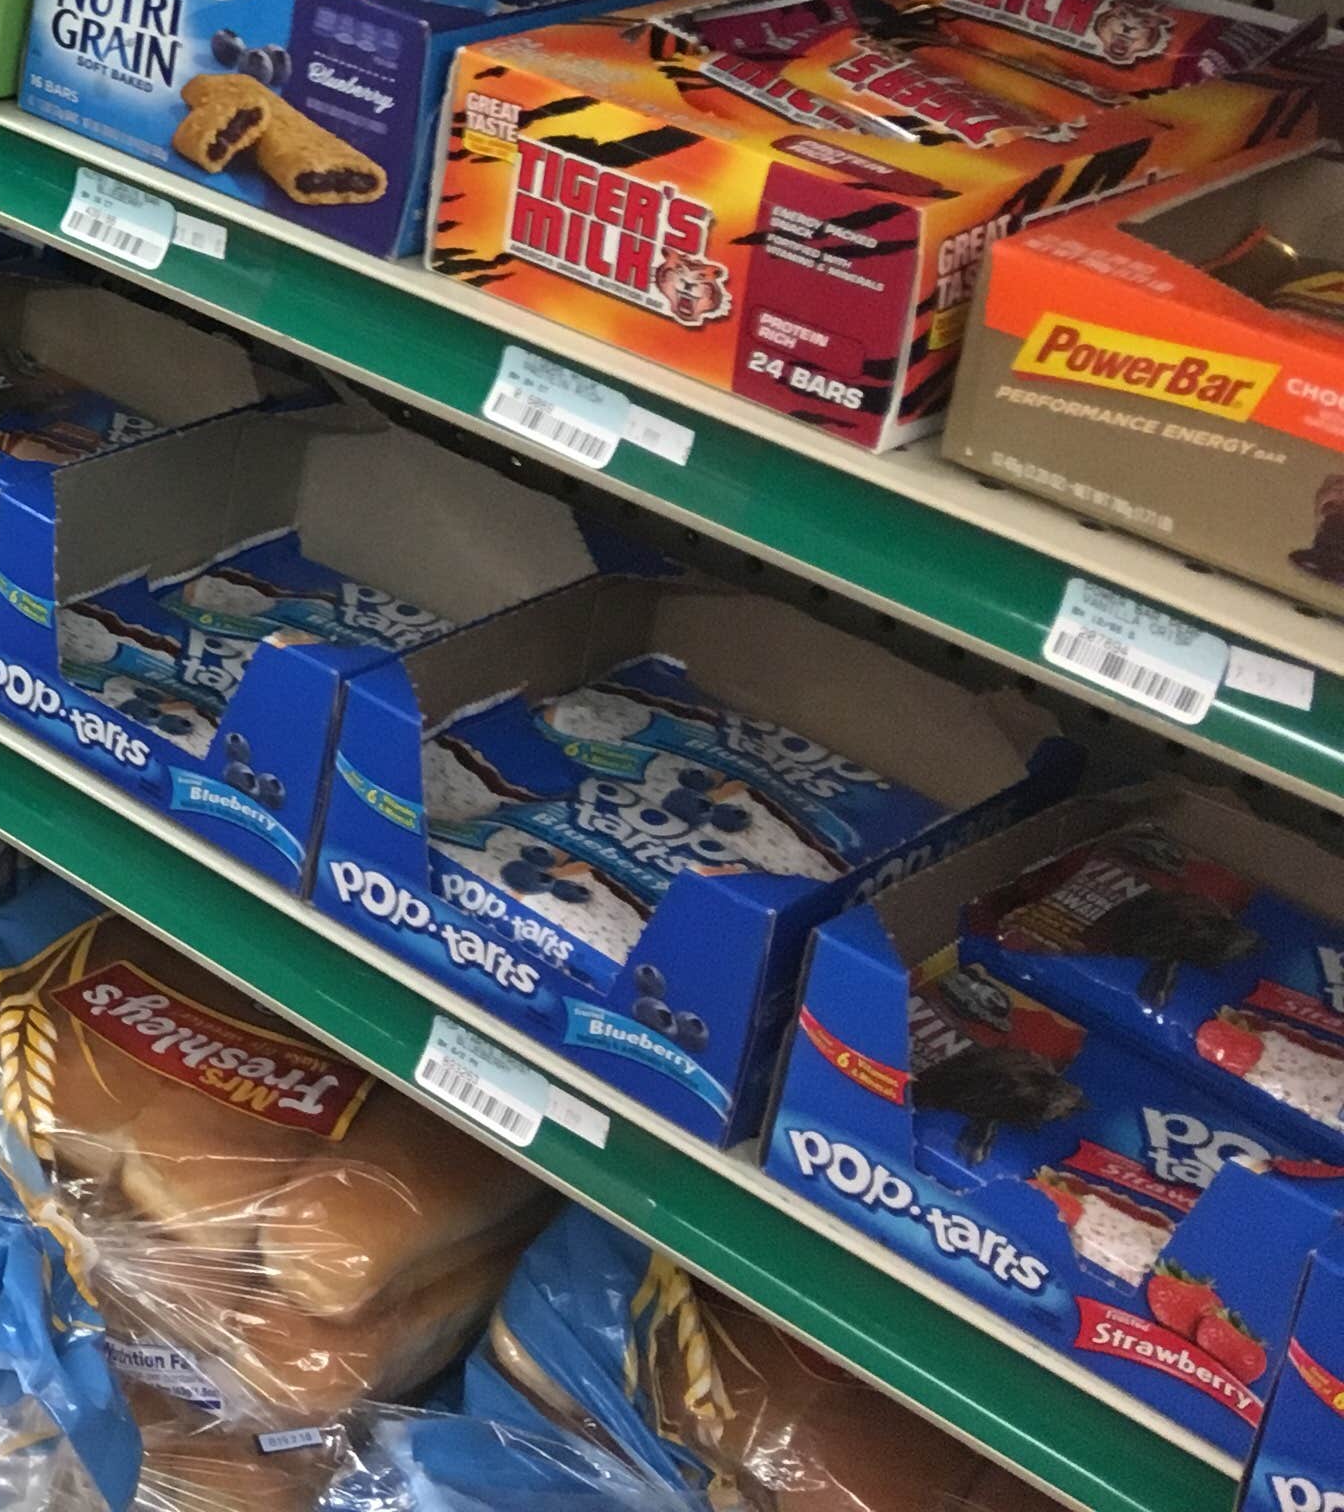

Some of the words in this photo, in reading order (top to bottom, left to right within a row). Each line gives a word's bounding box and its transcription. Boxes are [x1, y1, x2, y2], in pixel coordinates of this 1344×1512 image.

[51, 9, 182, 88] GRAIN
[77, 55, 109, 76] SOFT
[110, 67, 154, 94] BAKED
[44, 79, 80, 104] BARS
[307, 61, 397, 113] Blueberry
[466, 92, 521, 123] GREAT
[466, 111, 519, 143] TASTE
[516, 140, 708, 255] TIGER'S
[511, 192, 655, 292] MILK
[758, 326, 798, 350] RICH
[760, 312, 829, 348] PROTEIN
[747, 350, 785, 380] 24
[789, 366, 865, 410] BARS
[1036, 324, 1255, 408] PowerBar
[994, 385, 1159, 435] PERFORMANCE
[1162, 423, 1255, 457] ENERGY
[189, 785, 278, 833] Blueberry
[588, 1018, 698, 1075] Blueberry
[1092, 1322, 1253, 1412] Strawberry
